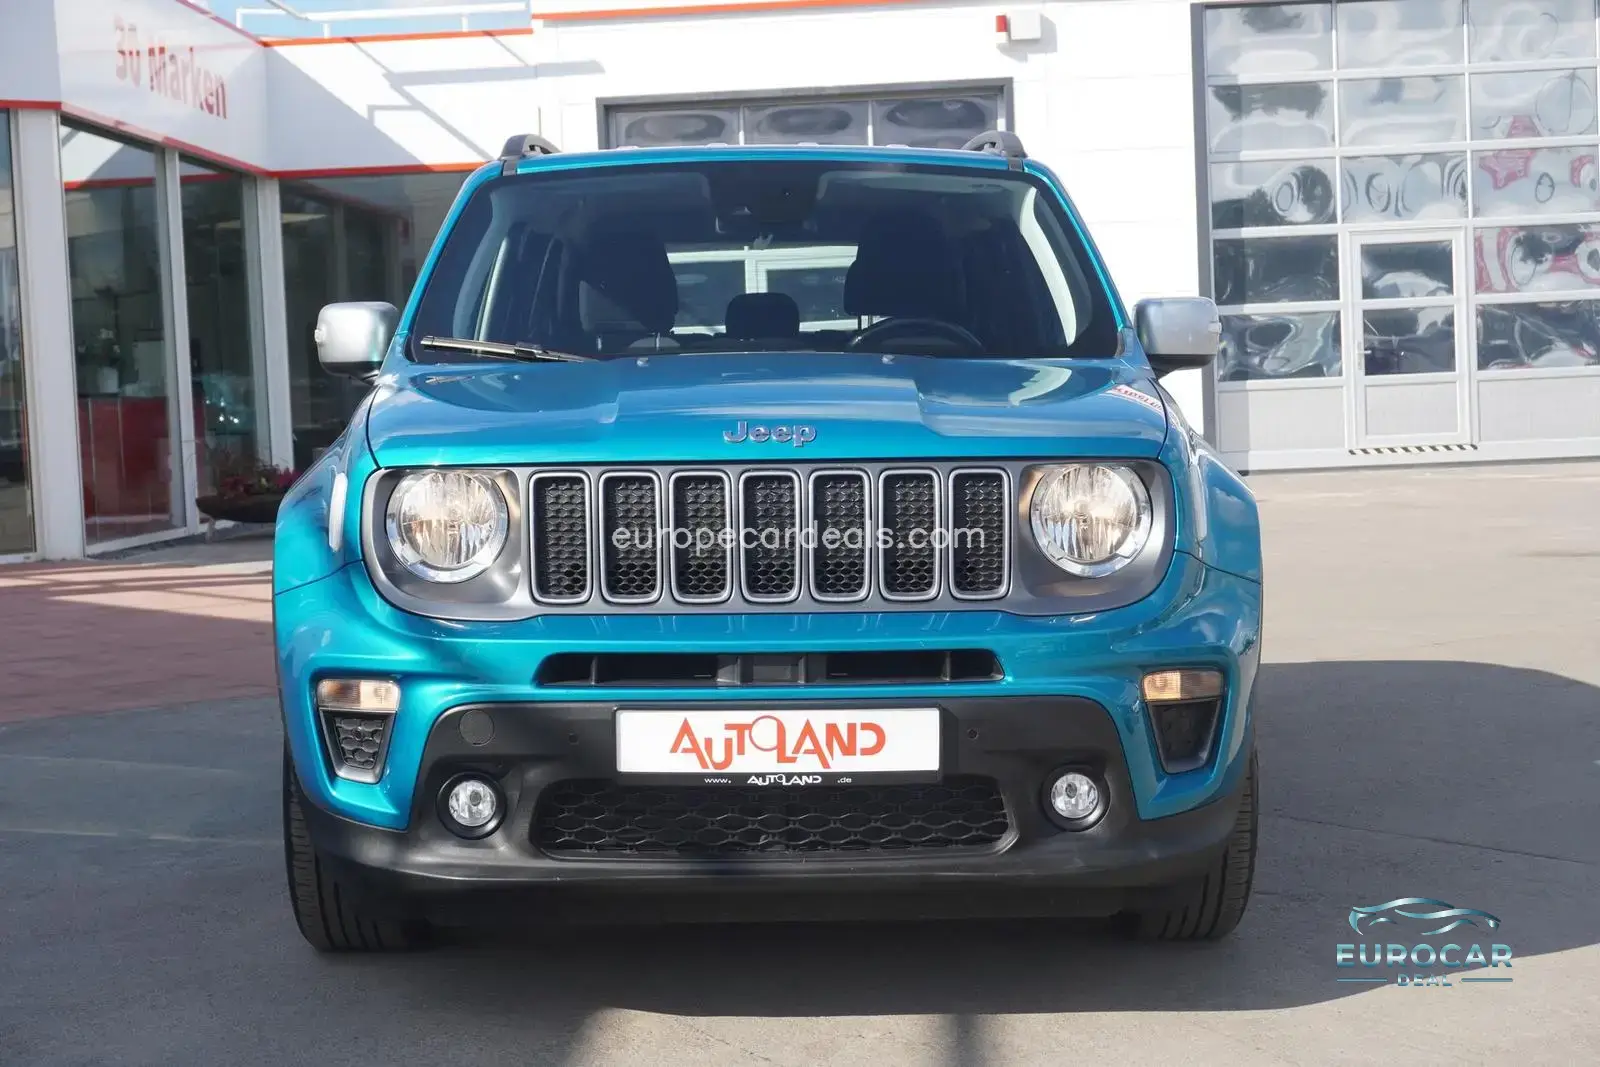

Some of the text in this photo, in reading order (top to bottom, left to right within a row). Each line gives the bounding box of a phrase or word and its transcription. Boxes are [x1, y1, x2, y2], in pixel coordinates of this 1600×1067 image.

[148, 38, 228, 120] Marken
[722, 420, 818, 447] Jeep
[669, 715, 886, 770] AUTOLAND
[704, 777, 732, 785] www.
